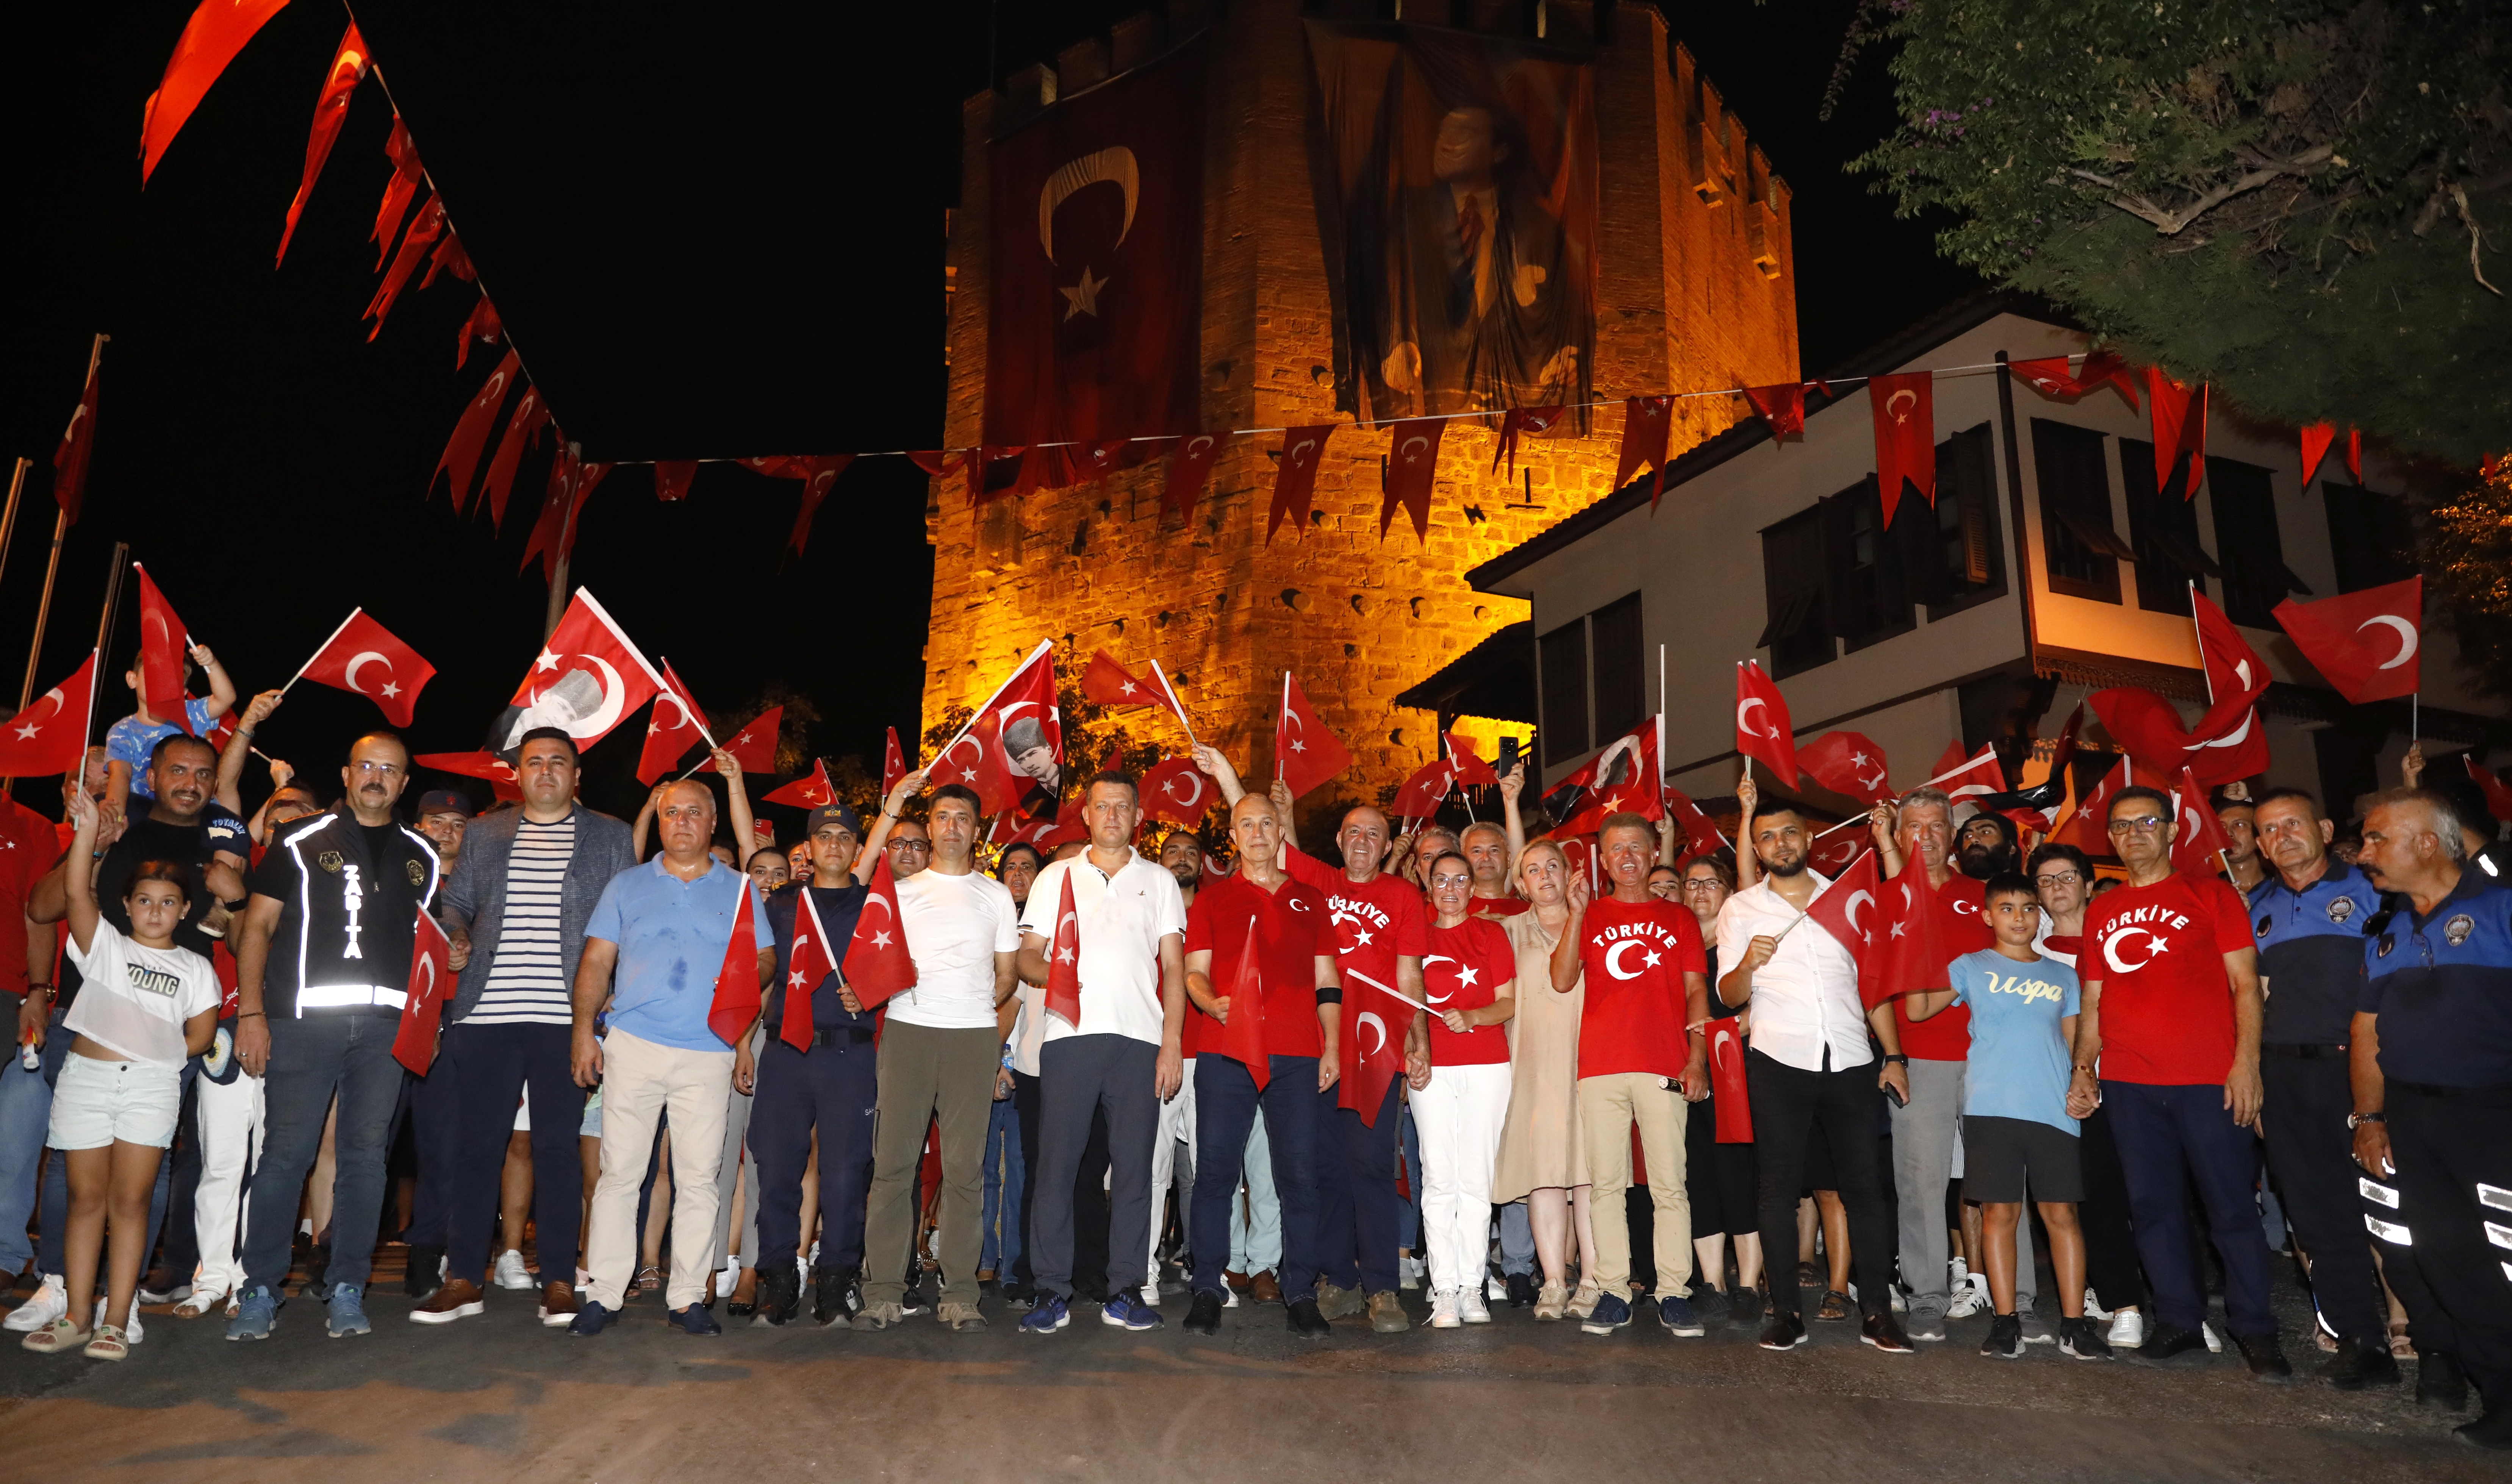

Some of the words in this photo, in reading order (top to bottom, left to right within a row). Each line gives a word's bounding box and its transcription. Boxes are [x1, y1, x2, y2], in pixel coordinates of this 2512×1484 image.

[212, 819, 246, 834] TOTALLY
[343, 865, 363, 958] ZABITA
[1326, 894, 1390, 929] ÜRKİYE
[2096, 904, 2190, 942] TÜRKİYE
[1592, 922, 1677, 949] TÜRKİYE
